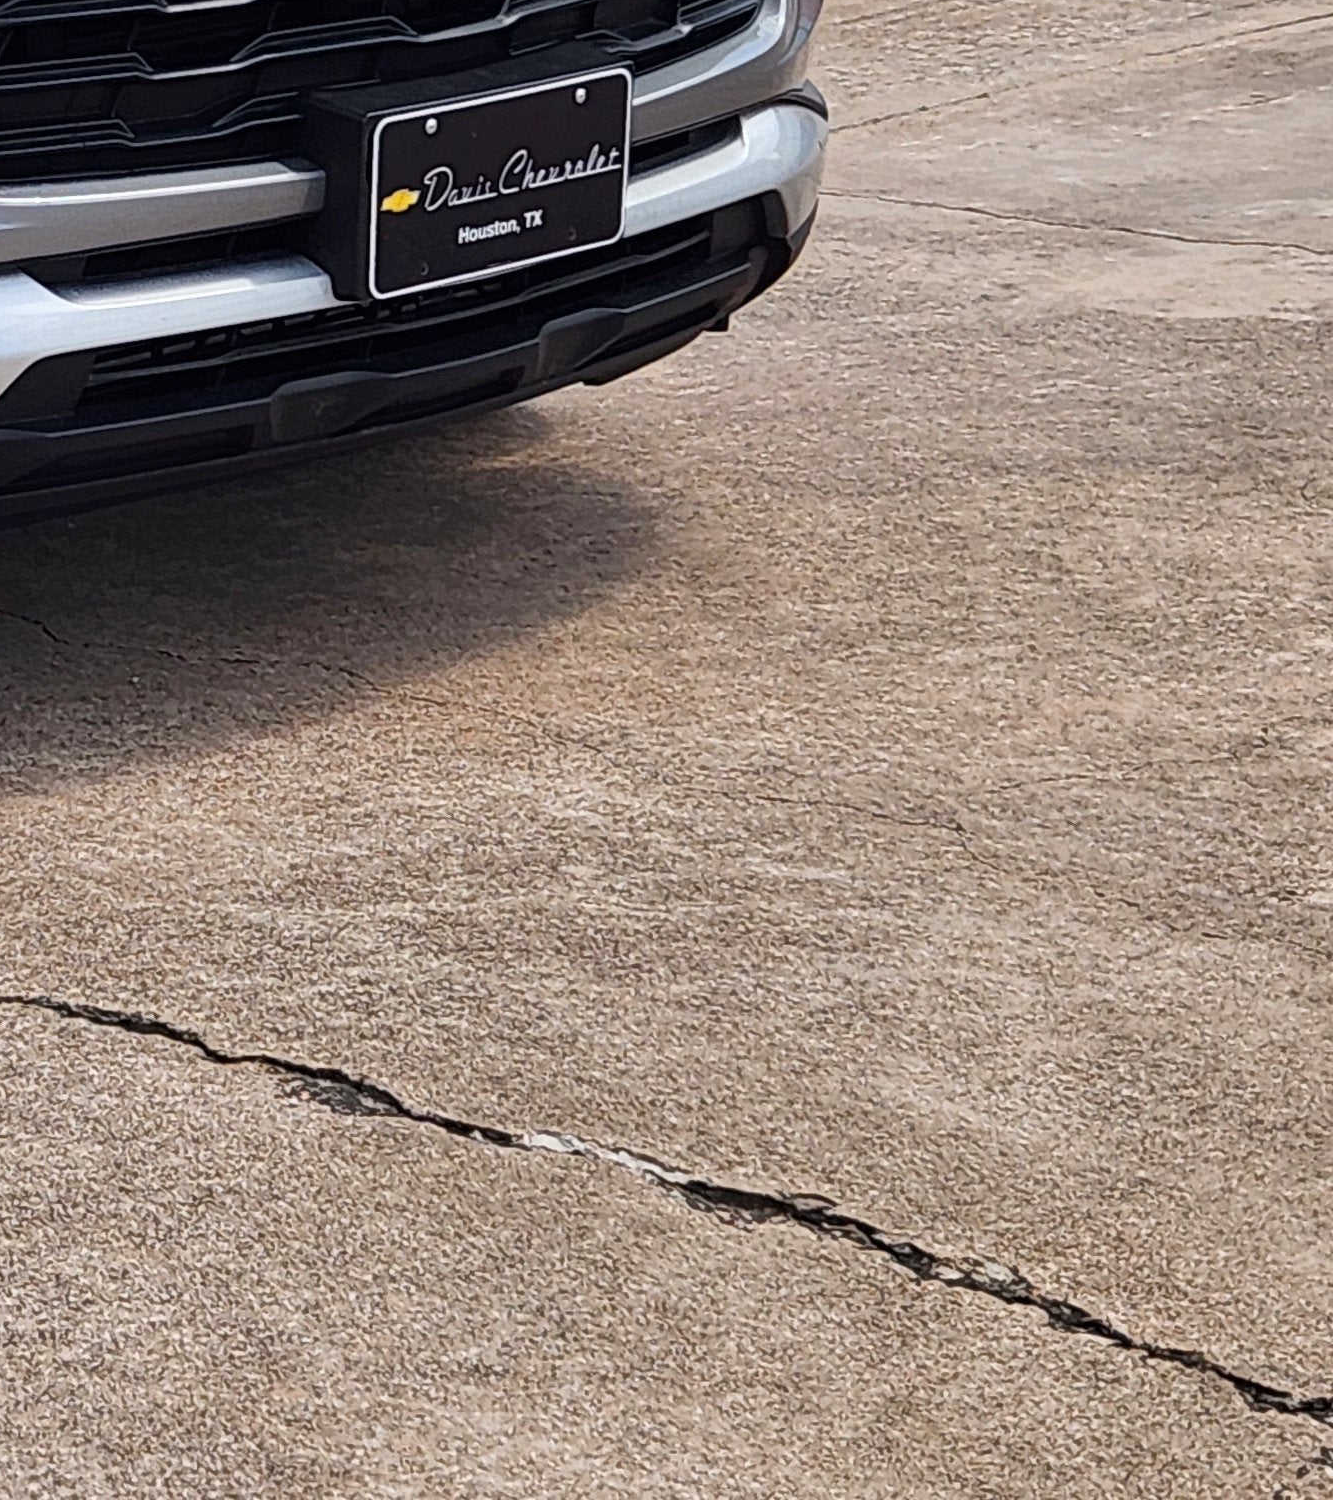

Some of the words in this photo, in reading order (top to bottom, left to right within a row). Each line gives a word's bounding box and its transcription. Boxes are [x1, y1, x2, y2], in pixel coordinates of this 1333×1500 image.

[424, 166, 498, 211] Davis
[499, 143, 621, 195] Chevrolet
[457, 217, 521, 244] Houston,
[523, 209, 544, 228] TX
